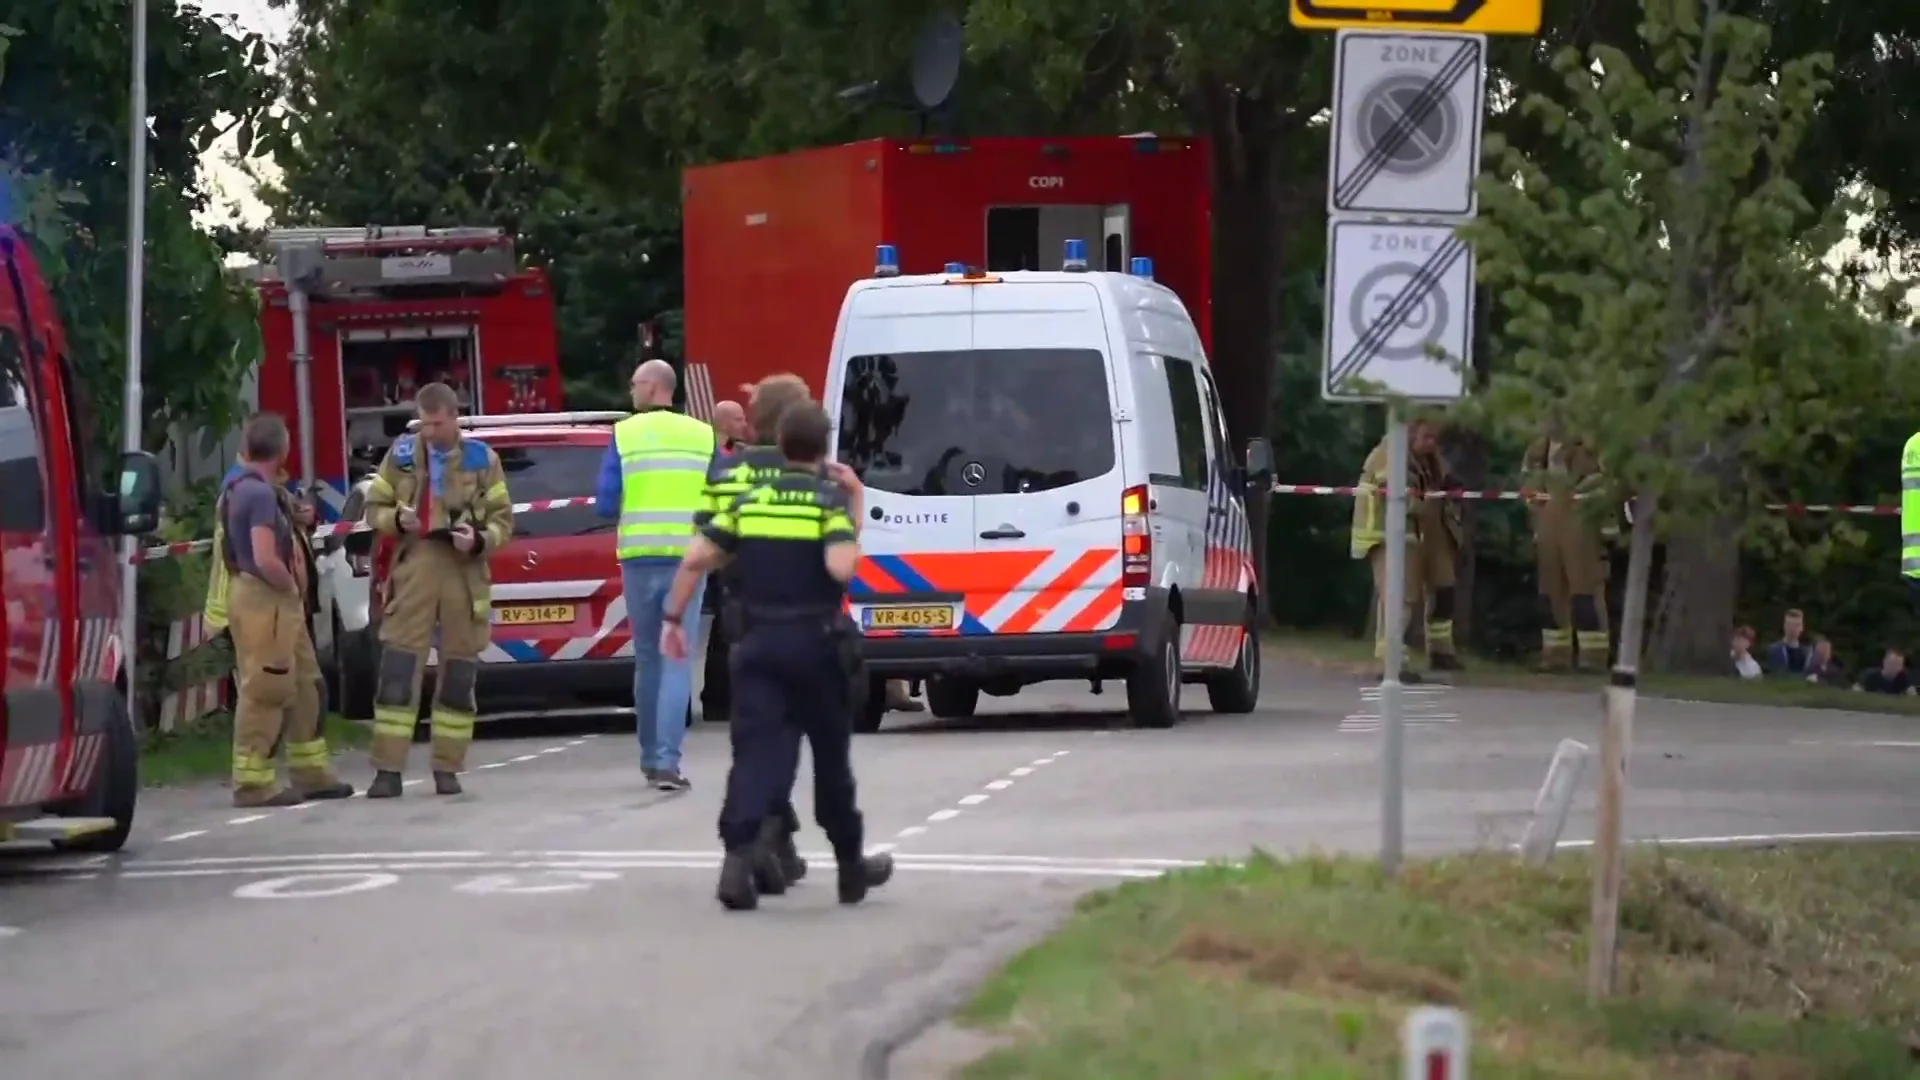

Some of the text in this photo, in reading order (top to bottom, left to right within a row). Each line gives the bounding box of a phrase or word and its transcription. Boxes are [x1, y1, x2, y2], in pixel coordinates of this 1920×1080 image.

[1380, 44, 1442, 64] ZONE
[1029, 175, 1064, 188] COPI
[1369, 232, 1435, 252] ZONE
[883, 513, 949, 524] POLITIE
[502, 606, 567, 621] RV-314-P
[875, 609, 949, 625] VR-405-S
